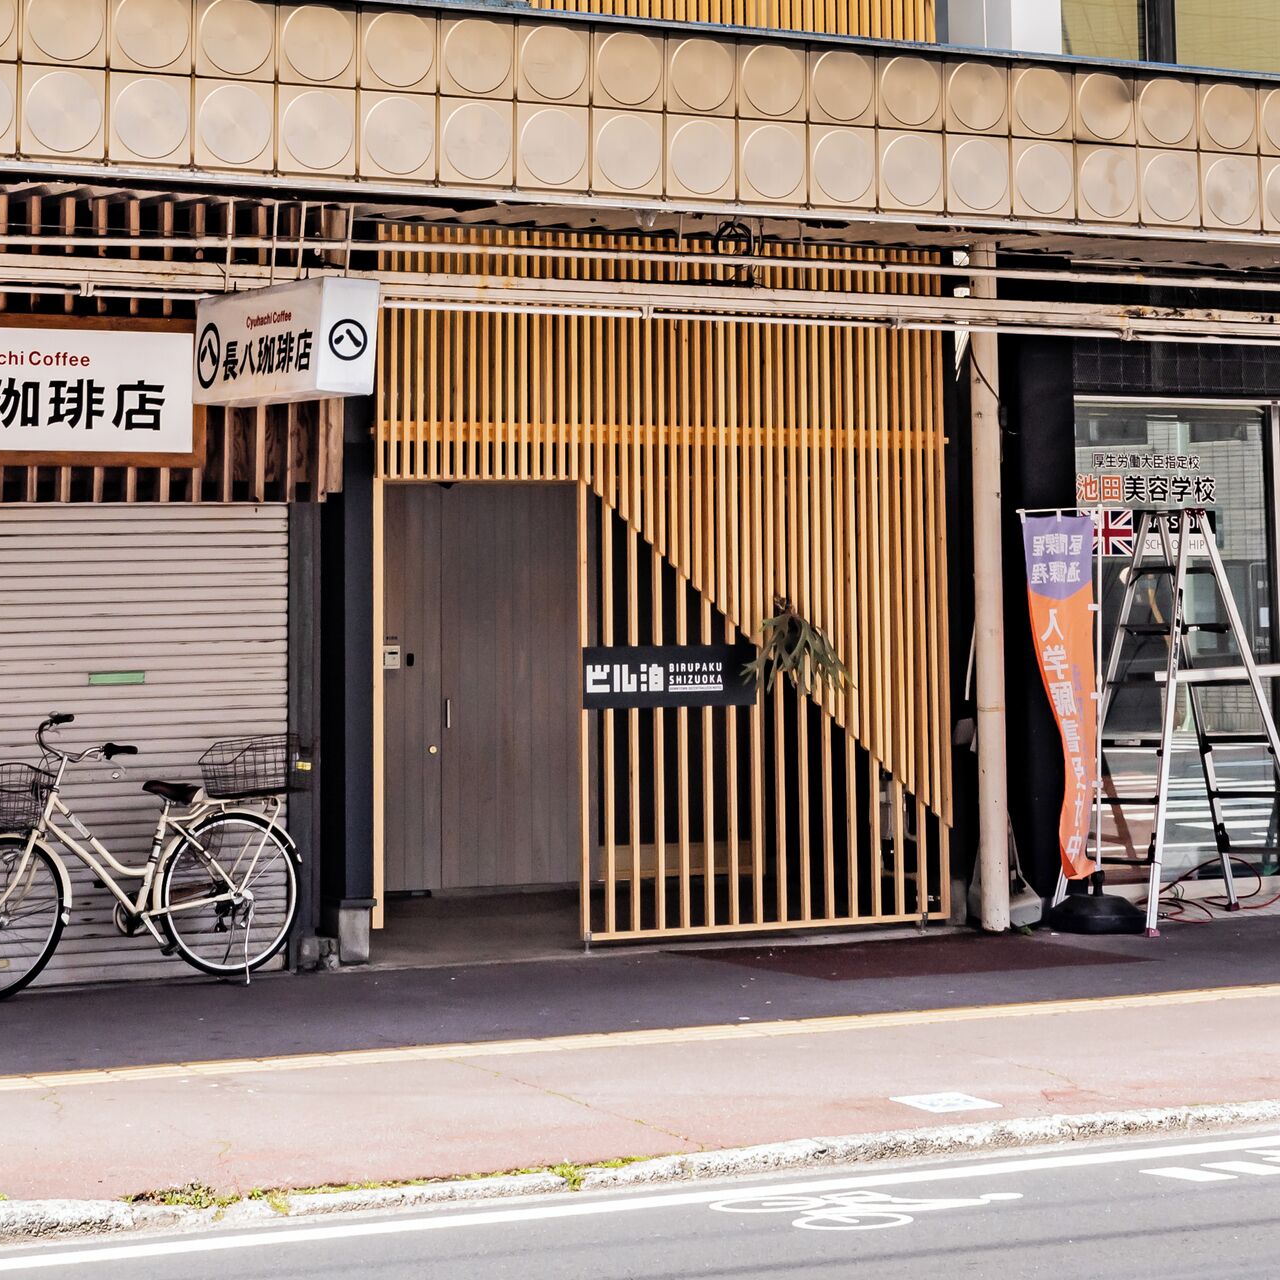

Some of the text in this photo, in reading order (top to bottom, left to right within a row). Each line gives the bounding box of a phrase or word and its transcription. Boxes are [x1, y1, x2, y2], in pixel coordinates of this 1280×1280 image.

[273, 310, 293, 324] Coffee
[28, 350, 91, 368] Coffee
[222, 328, 313, 382] 長八珈琲店
[1092, 452, 1201, 470] 厚生労働大臣指定校
[1076, 474, 1216, 504] 池田美容学校
[669, 662, 723, 673] BIRUPAKU
[586, 663, 664, 694] ビル泊
[669, 674, 723, 685] SHIZUOKA
